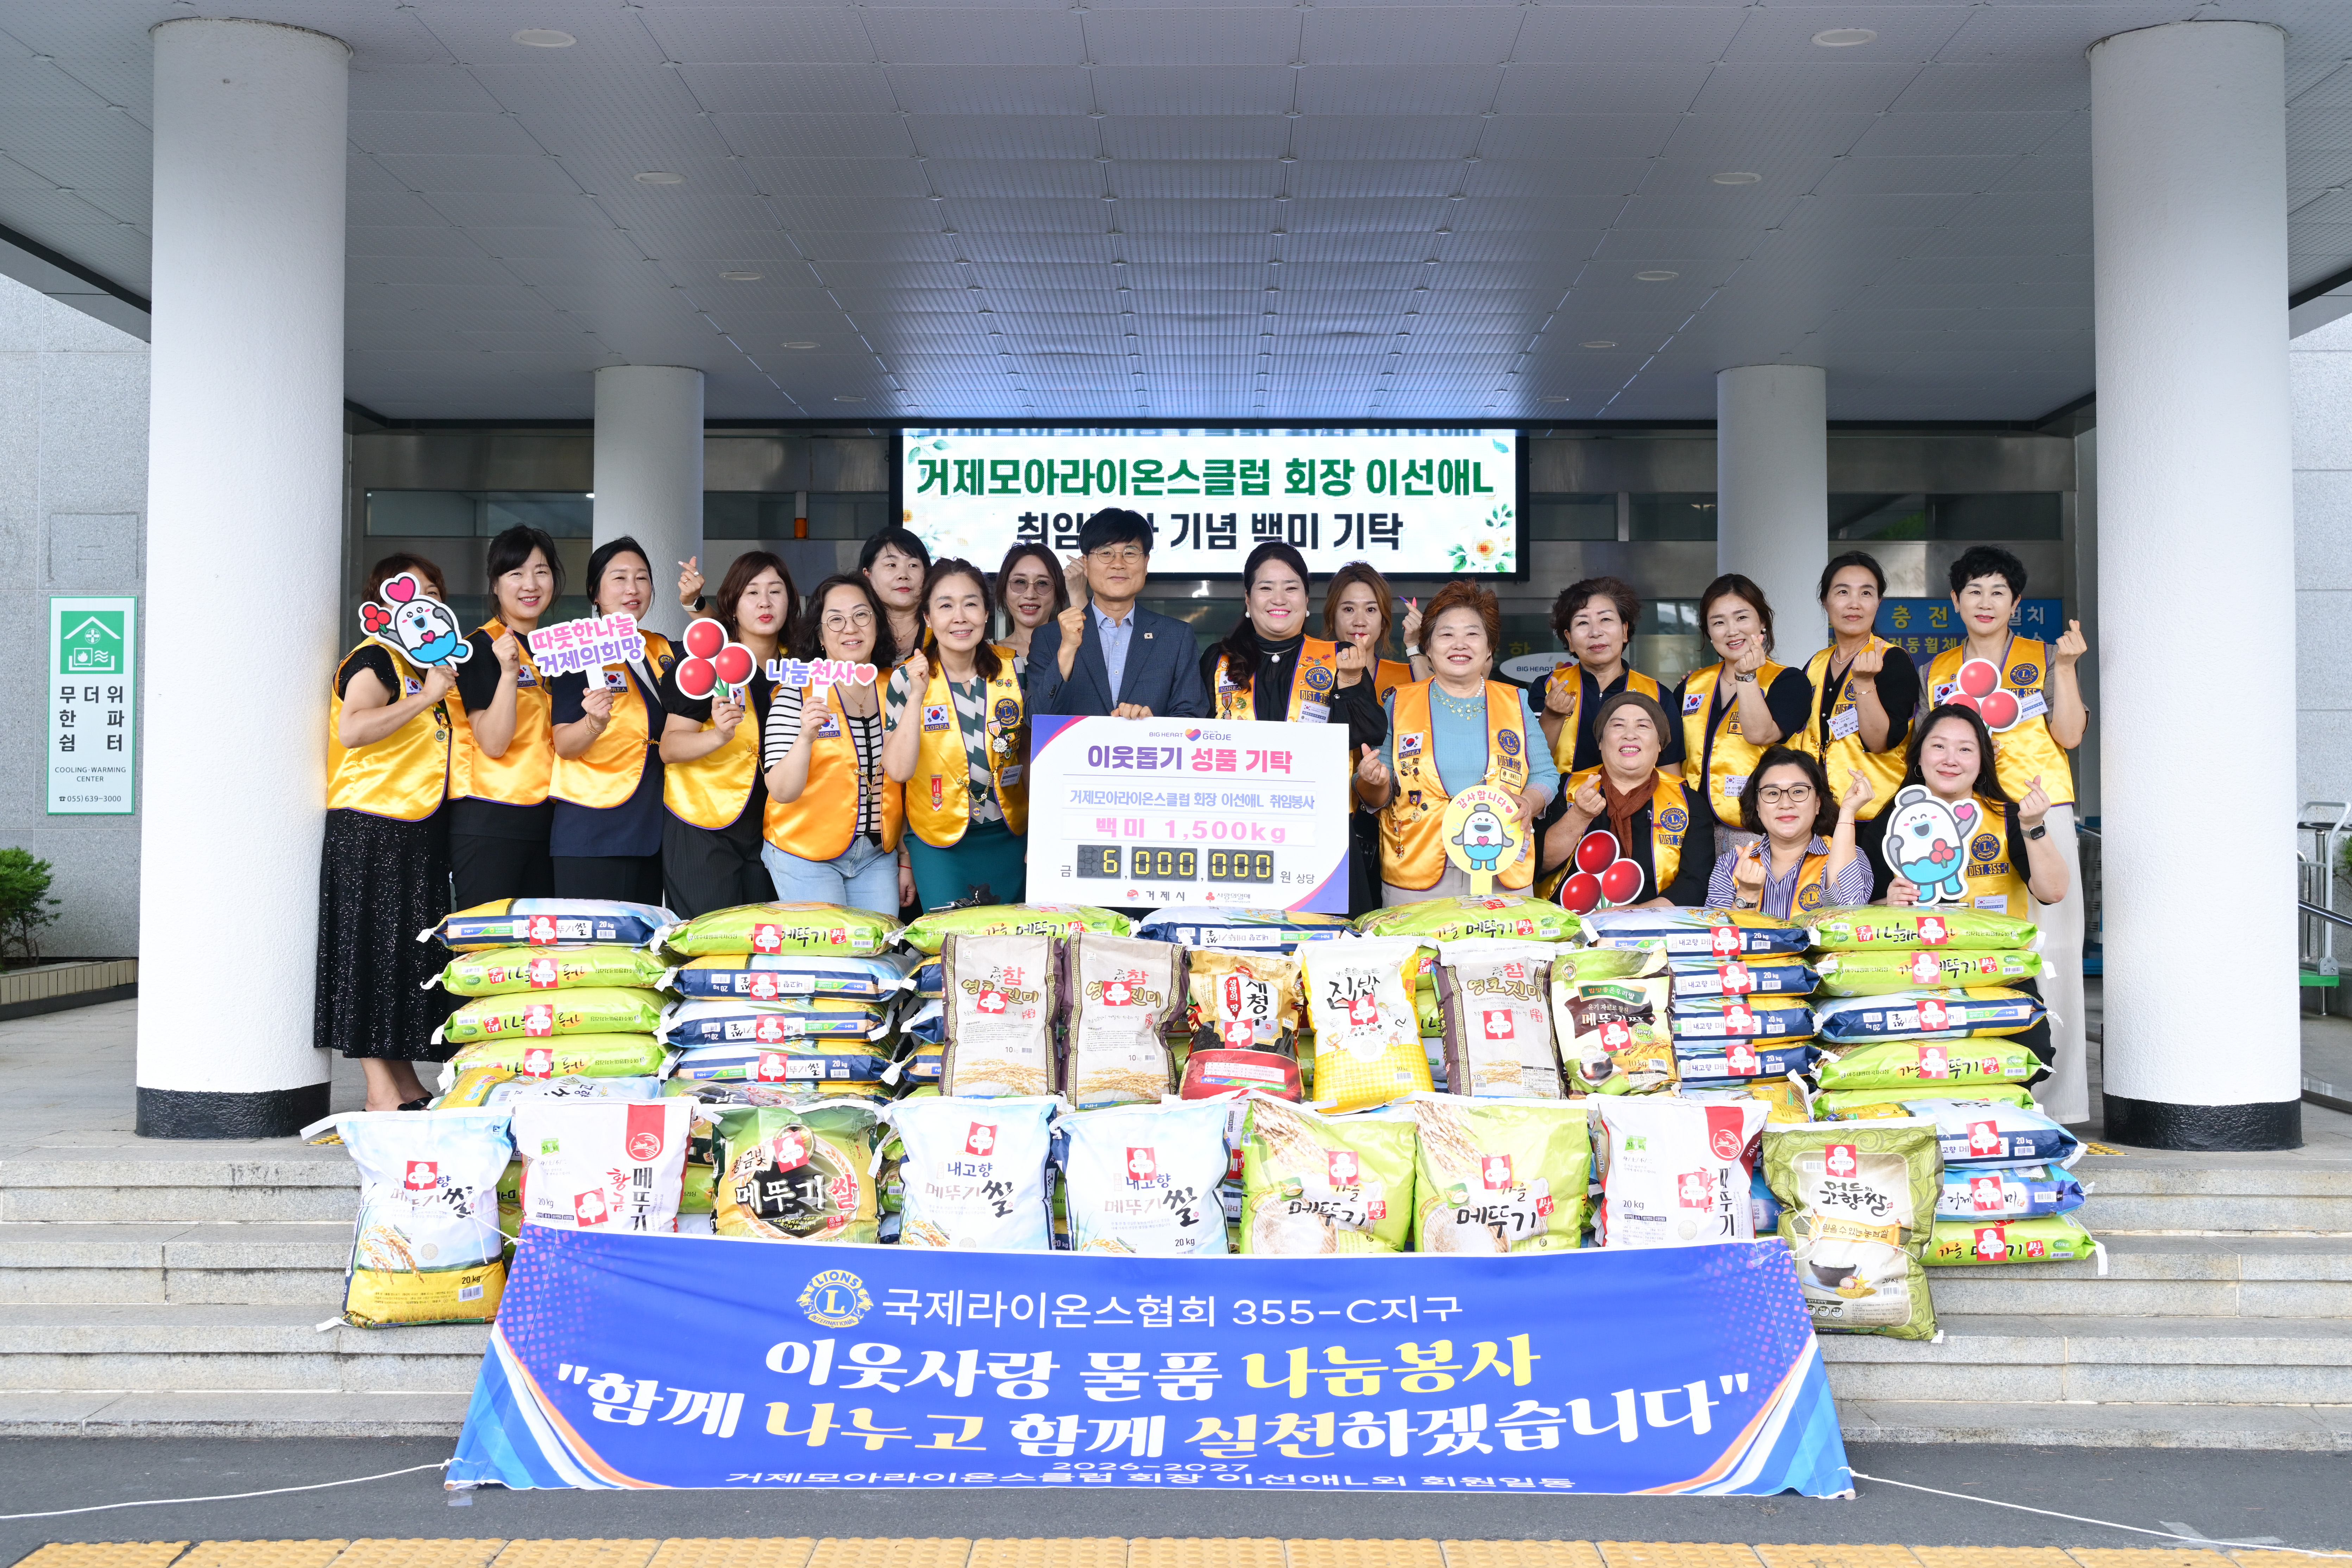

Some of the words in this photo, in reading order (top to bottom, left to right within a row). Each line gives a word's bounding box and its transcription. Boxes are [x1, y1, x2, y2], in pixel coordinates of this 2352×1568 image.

[917, 459, 1270, 496] 거제모아라이온스클럽
[1284, 459, 1354, 496] 회장
[1366, 459, 1494, 497] 이선애L
[1170, 512, 1236, 550] 기념
[1252, 512, 1319, 550] 백미
[1333, 512, 1403, 550] 기탁
[532, 614, 634, 650] 따뜻한나눔
[537, 635, 643, 673] 거제의희망
[769, 659, 855, 685] 나눔천사
[1301, 691, 1317, 701] DIST.
[1004, 707, 1011, 716] L
[1088, 745, 1182, 770] 이웃돕기
[1191, 748, 1237, 772] 성품
[1246, 750, 1293, 774] 기탁
[1401, 750, 1420, 758] KOREA
[1070, 790, 1190, 807] 거제모아라이온스클럽
[1194, 792, 1217, 807] 회장
[1221, 793, 1264, 808] 이선애L
[1270, 794, 1315, 809] 취임봉사
[1456, 789, 1507, 809] 감사합니다
[1096, 818, 1144, 838] 백미
[1164, 820, 1285, 844] 1,500kg
[1060, 865, 1072, 877] 금
[1279, 871, 1290, 882] 원
[1296, 873, 1315, 884] 상당
[1988, 863, 2007, 874] 355-C
[1146, 891, 1185, 901] 거제시
[1216, 892, 1251, 900] 사랑의열매
[575, 923, 587, 936] 쌀
[831, 929, 845, 944] 쌀
[1016, 921, 1065, 936] 메뚜기
[1436, 923, 1459, 939] 가을
[1466, 922, 1513, 938] 메뚜기
[1003, 966, 1025, 986] 참
[1127, 969, 1149, 985] 참
[1503, 963, 1524, 978] 참
[1086, 981, 1161, 1008] 영진미
[1467, 977, 1541, 1002] 영호진미
[1588, 987, 1635, 1001] 밥맛좋은우리쌀
[1230, 1003, 1238, 1013] 땅
[1635, 1028, 1653, 1039] 햅쌀
[1693, 1022, 1712, 1030] 내고향
[732, 1148, 767, 1174] 황금빛
[948, 1161, 993, 1177] 내고향
[735, 1175, 824, 1214] 메뚜기
[925, 1182, 980, 1201] 메뚜기
[1105, 1198, 1161, 1215] 메뚜기
[1622, 1200, 1632, 1208] 20
[1819, 1190, 1890, 1217] 고향쌀
[1288, 1201, 1366, 1226] 메뚜기
[1457, 1205, 1536, 1239] 메뚜기
[1839, 1226, 1847, 1234] 수
[1849, 1227, 1862, 1236] 있는
[1864, 1229, 1889, 1239] 농협쌀
[1175, 1239, 1184, 1247] 20
[1939, 1242, 1963, 1259] 가을
[461, 1276, 470, 1284] 20
[815, 1271, 859, 1287] LIONS
[882, 1289, 1215, 1328] 국제라이온스협회
[1232, 1295, 1463, 1325] 355-C지구
[765, 1338, 1059, 1400] 이웃사랑
[1080, 1351, 1222, 1402] 물품
[1241, 1334, 1540, 1399] 나눔봉사
[764, 1402, 987, 1451] 나누고
[1010, 1411, 1165, 1458] 함께
[1053, 1461, 1249, 1472] 2026-2027
[726, 1472, 1119, 1484] 거제모아라이온스클럽
[1128, 1473, 1199, 1485] 회장
